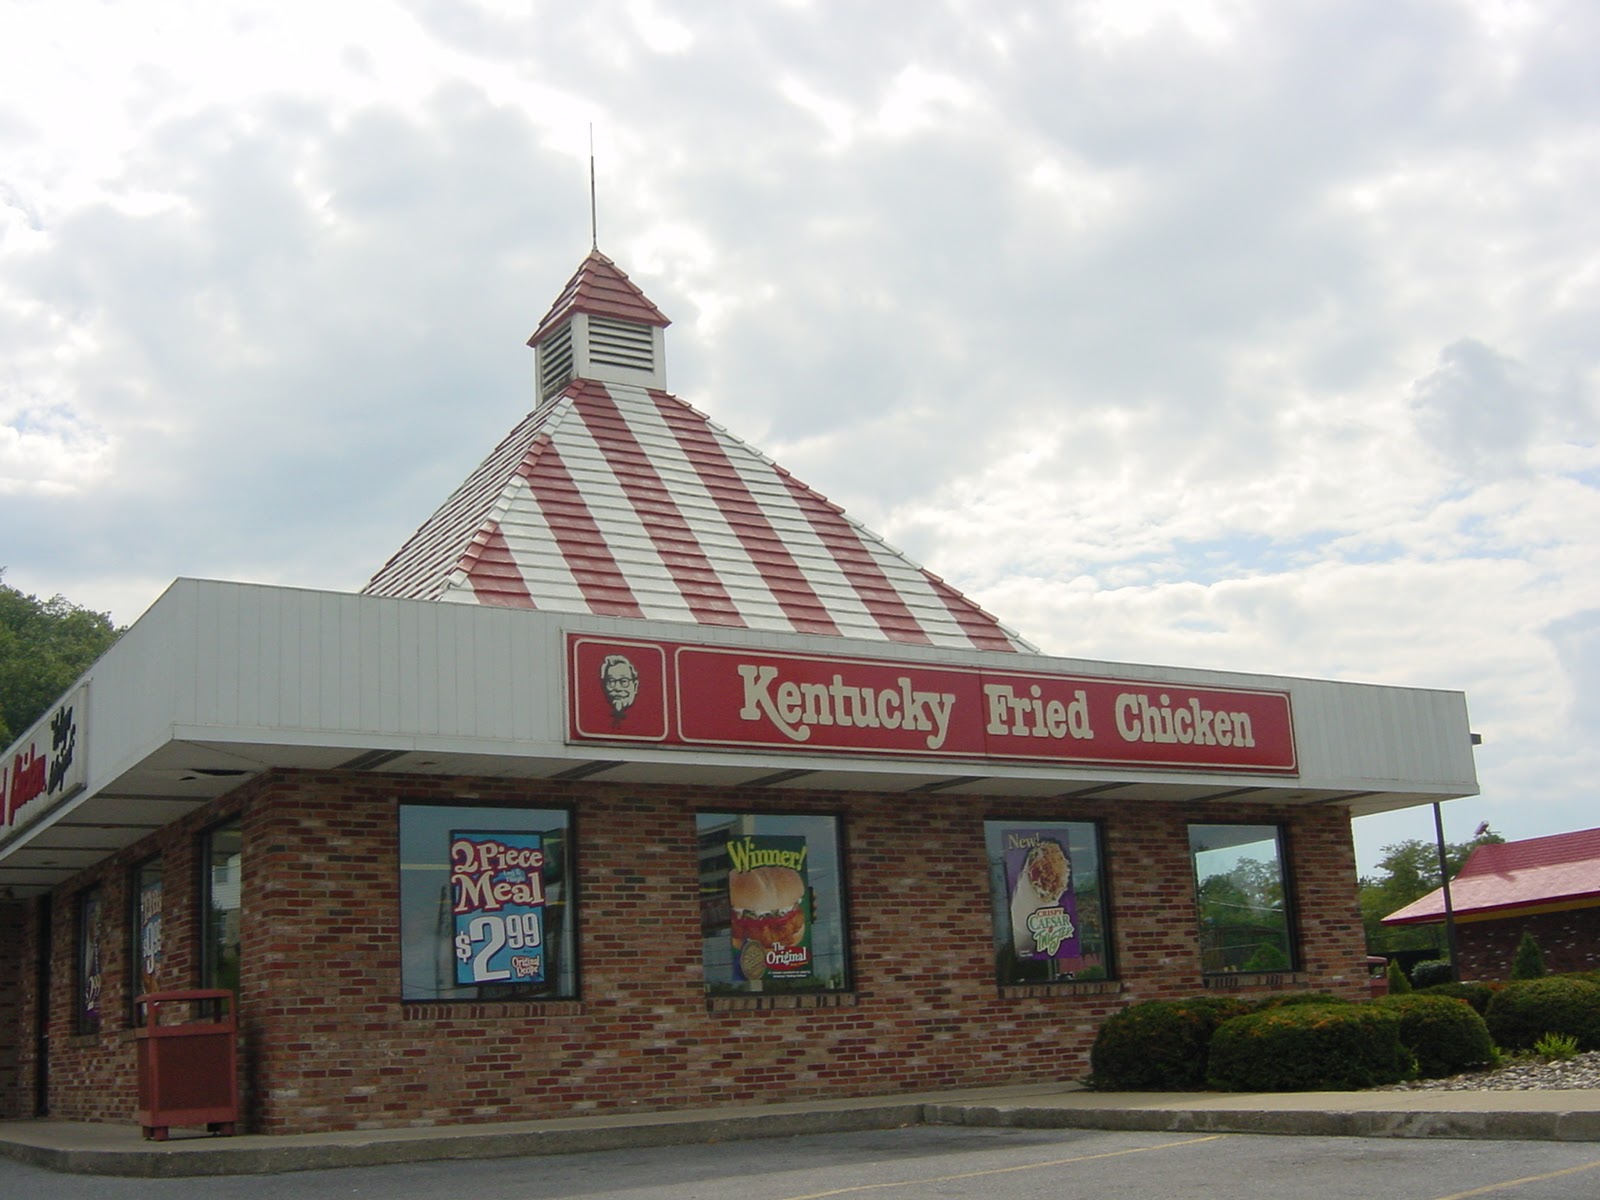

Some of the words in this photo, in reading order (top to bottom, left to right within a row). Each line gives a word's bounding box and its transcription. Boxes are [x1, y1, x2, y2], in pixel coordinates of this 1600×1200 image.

[737, 664, 956, 750] Kentucky
[983, 683, 1095, 741] Fried
[1115, 692, 1256, 748] Chicken
[451, 841, 478, 873] 2
[477, 842, 543, 871] Piece
[727, 836, 806, 872] Winner!
[1008, 832, 1041, 849] New!
[451, 871, 544, 912] Meal
[766, 947, 807, 965] Original
